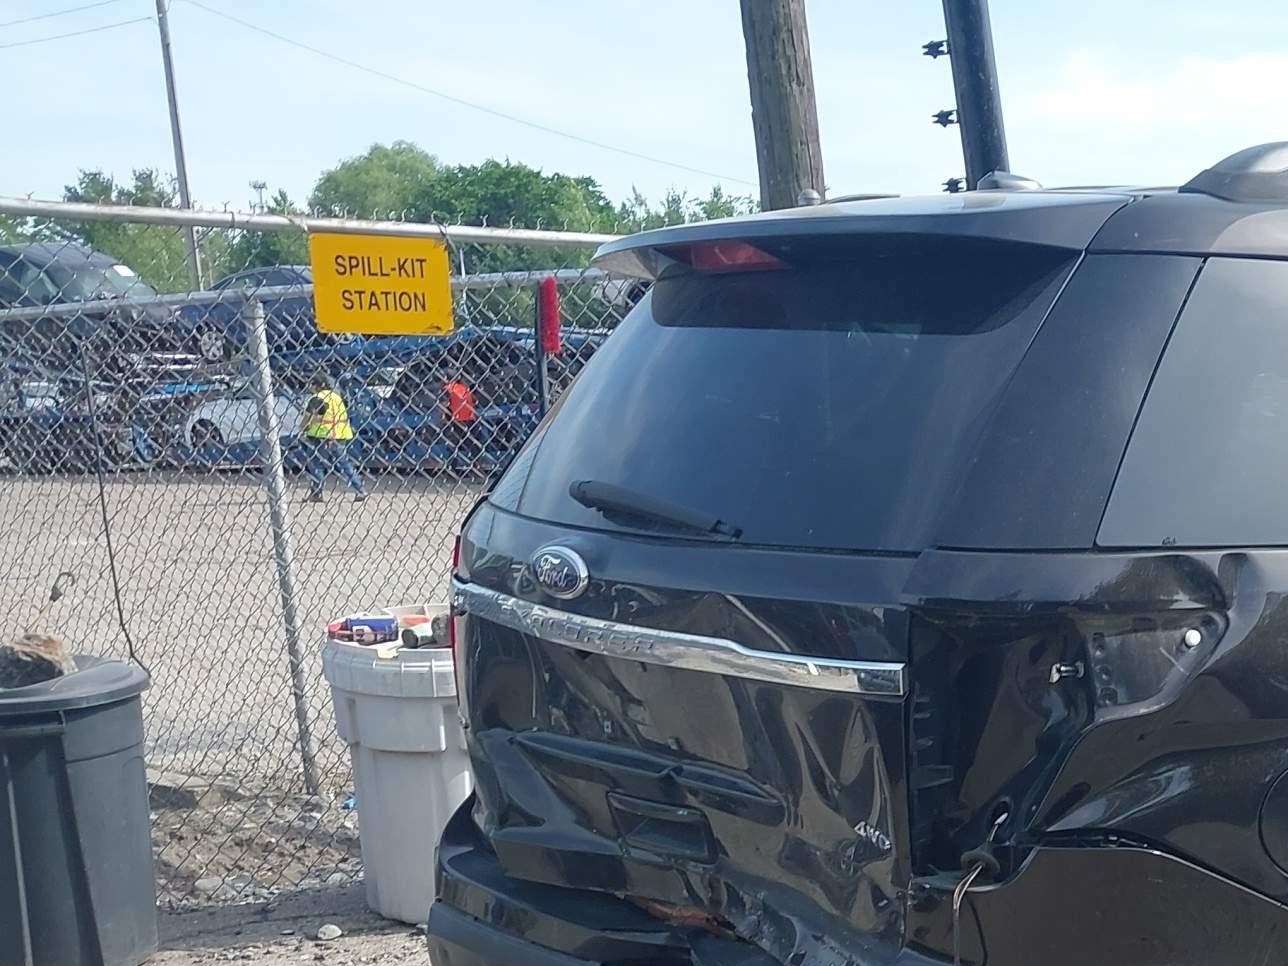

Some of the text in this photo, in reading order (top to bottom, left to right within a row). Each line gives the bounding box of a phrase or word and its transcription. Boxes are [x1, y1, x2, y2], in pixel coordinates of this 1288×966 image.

[334, 254, 427, 279] SPILL-KIT
[341, 289, 426, 312] STATION
[537, 554, 570, 588] Ford
[854, 821, 891, 850] 4WD
